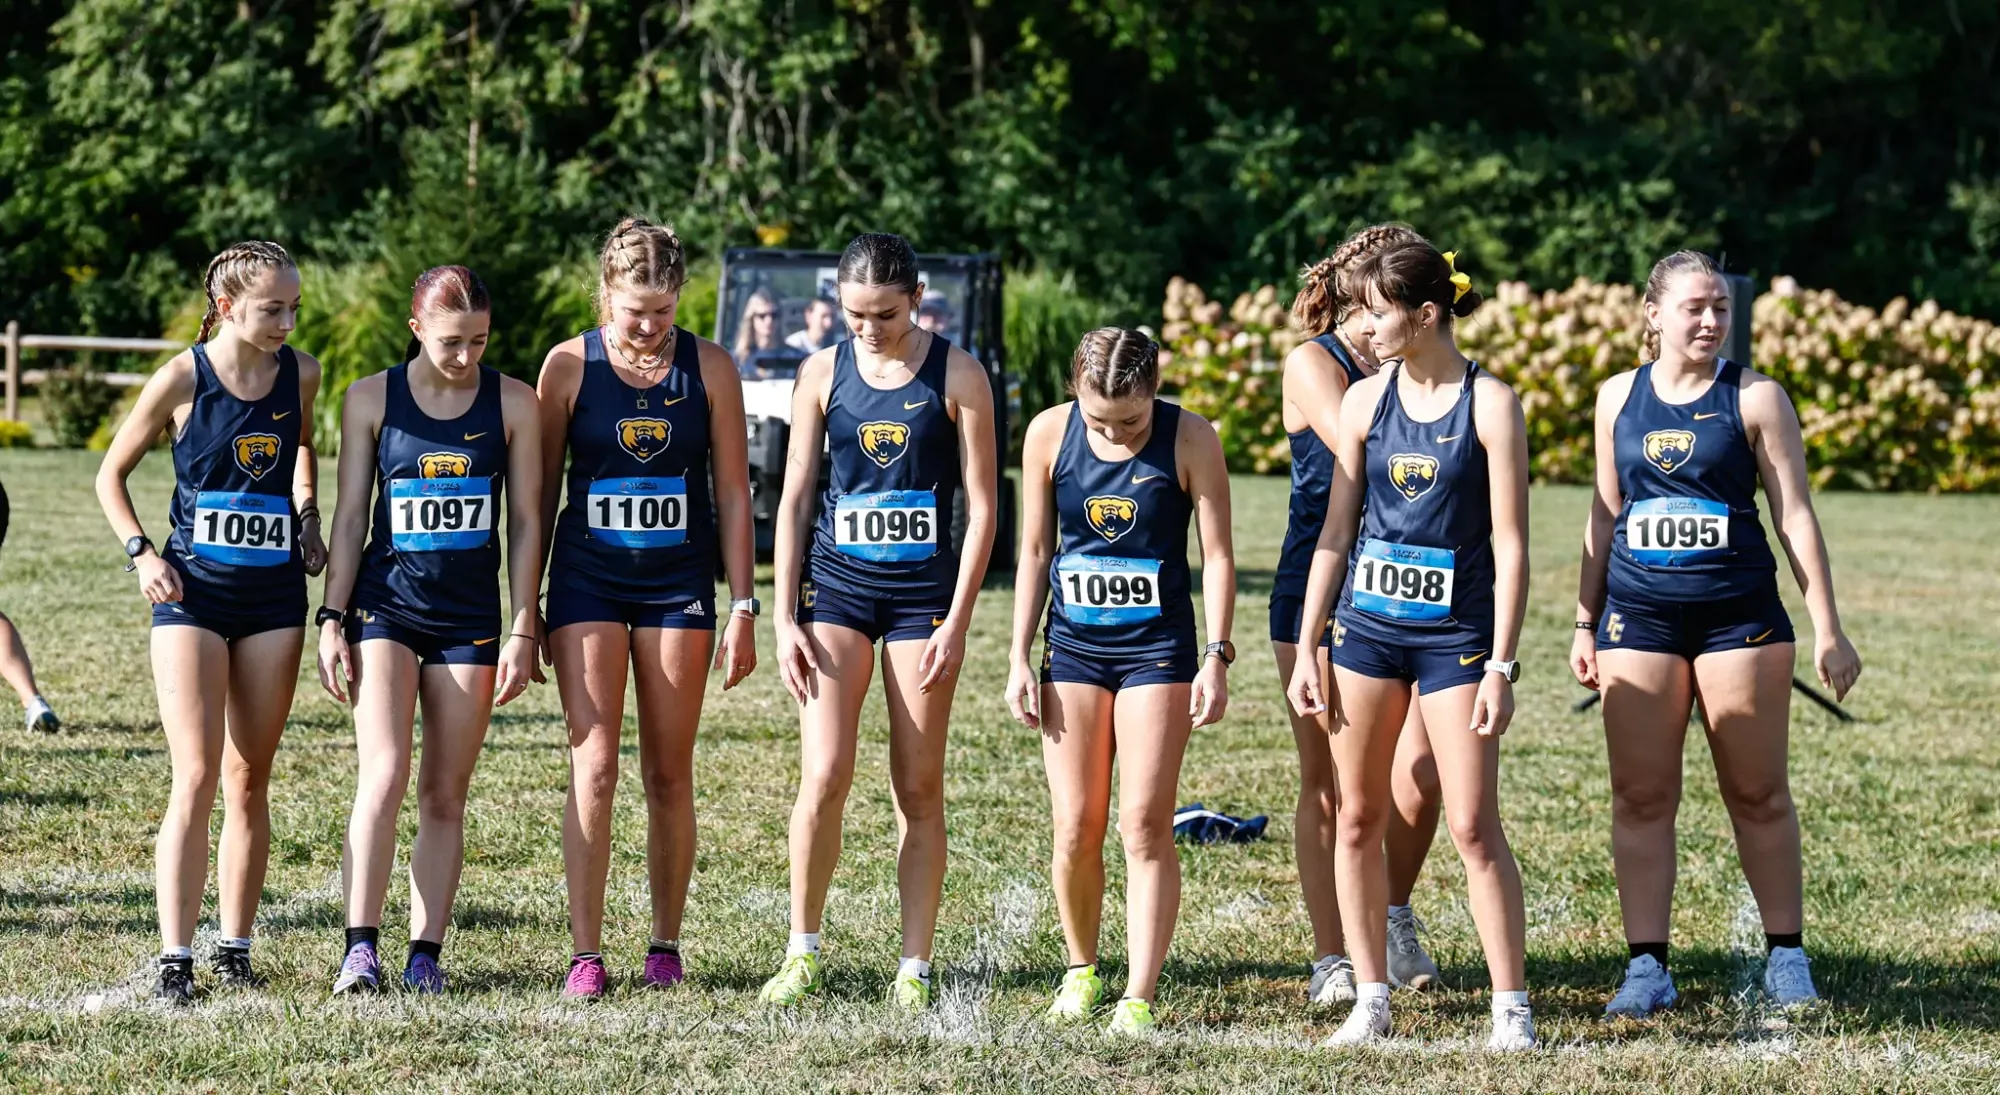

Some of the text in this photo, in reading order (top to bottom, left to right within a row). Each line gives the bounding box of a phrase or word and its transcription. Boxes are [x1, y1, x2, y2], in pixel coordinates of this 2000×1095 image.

[399, 498, 485, 531] 1097
[596, 497, 681, 528] 1100
[843, 510, 930, 542] 1096
[204, 511, 285, 548] 1094
[1635, 517, 1720, 548] 1095
[1068, 573, 1152, 605] 1099
[1363, 560, 1445, 602] 1098
[683, 608, 705, 617] adidas
[1606, 612, 1625, 644] FC
